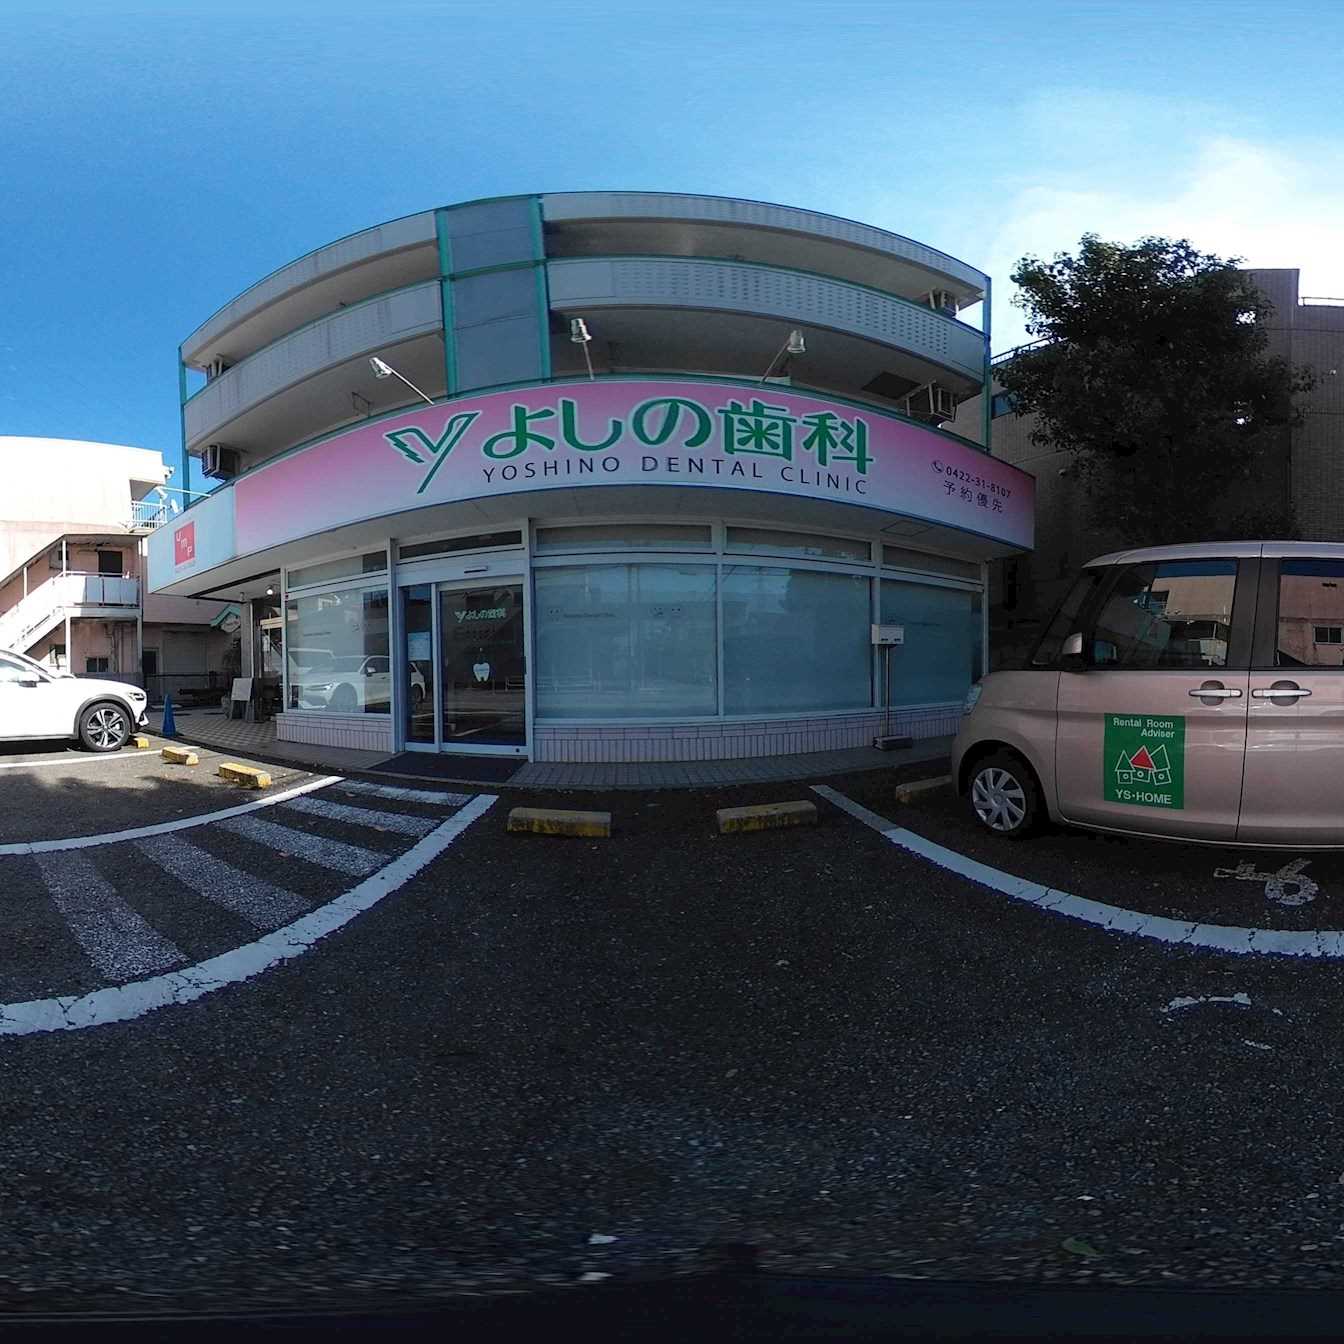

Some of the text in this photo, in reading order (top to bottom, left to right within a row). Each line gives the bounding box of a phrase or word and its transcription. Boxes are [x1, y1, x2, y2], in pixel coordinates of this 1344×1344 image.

[482, 398, 874, 475] よしの歯科
[483, 456, 868, 495] YOSHINO DENTAL CLINIC
[946, 466, 1012, 498] 0422-31-8107
[943, 480, 1003, 513] 予約優先
[1113, 717, 1174, 729] Rental Room
[1140, 728, 1175, 738] Adviser
